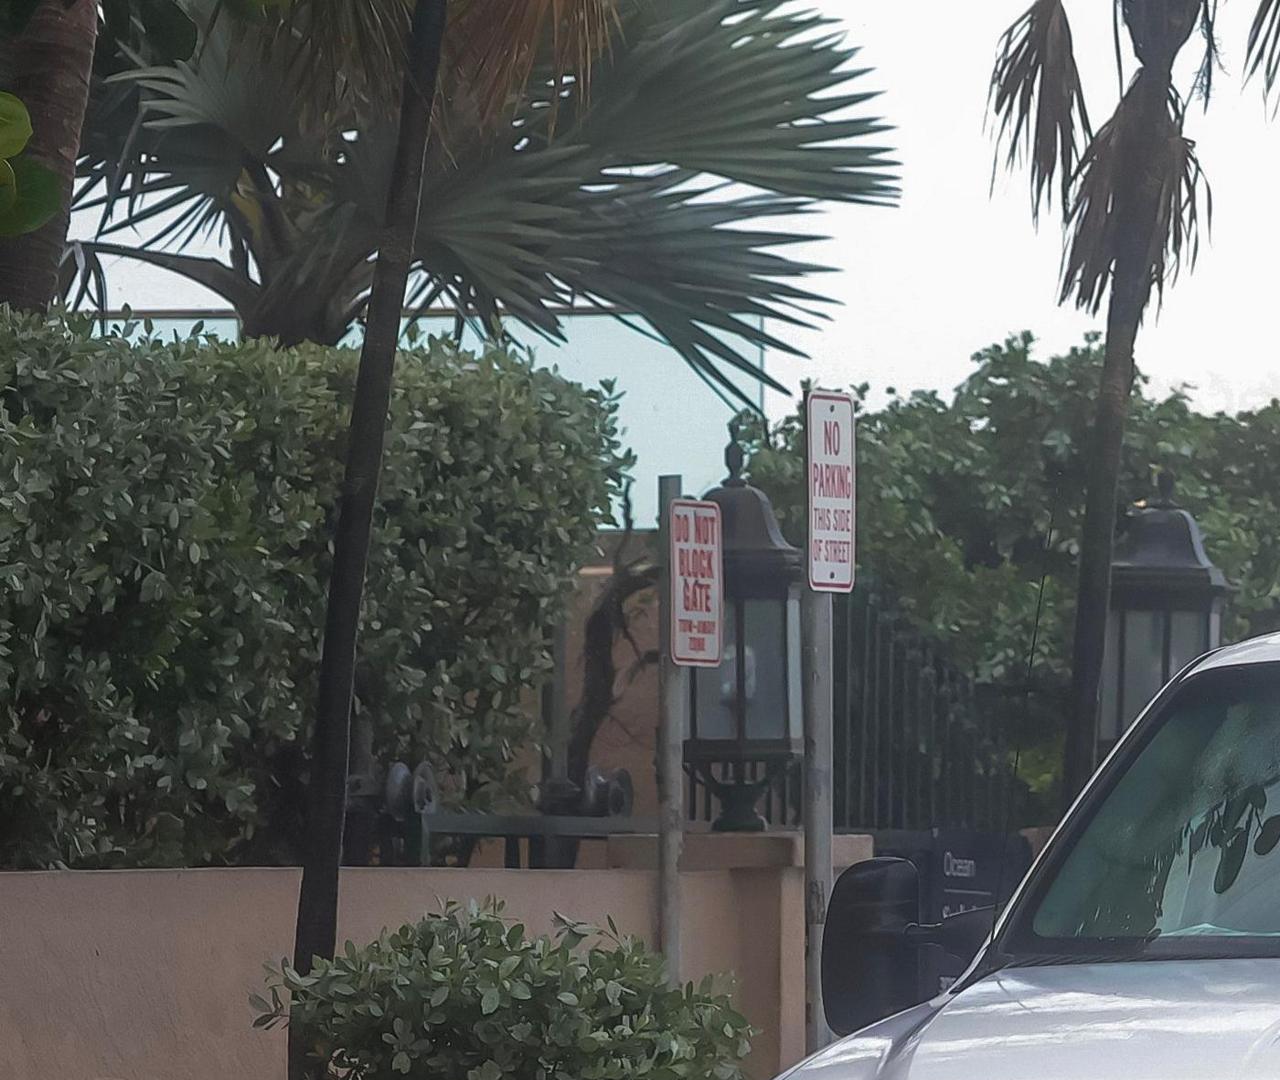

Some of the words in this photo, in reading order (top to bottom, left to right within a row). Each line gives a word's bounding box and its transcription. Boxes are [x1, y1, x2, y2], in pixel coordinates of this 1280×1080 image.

[824, 420, 840, 456] NO
[813, 463, 851, 499] PARKING
[674, 513, 690, 543] DO
[695, 515, 716, 545] NOT
[814, 508, 831, 531] THIS
[833, 509, 851, 532] SIDE
[679, 549, 714, 578] BLOCK
[813, 539, 823, 561] OF
[825, 540, 851, 563] STREET
[683, 582, 711, 612] GATE
